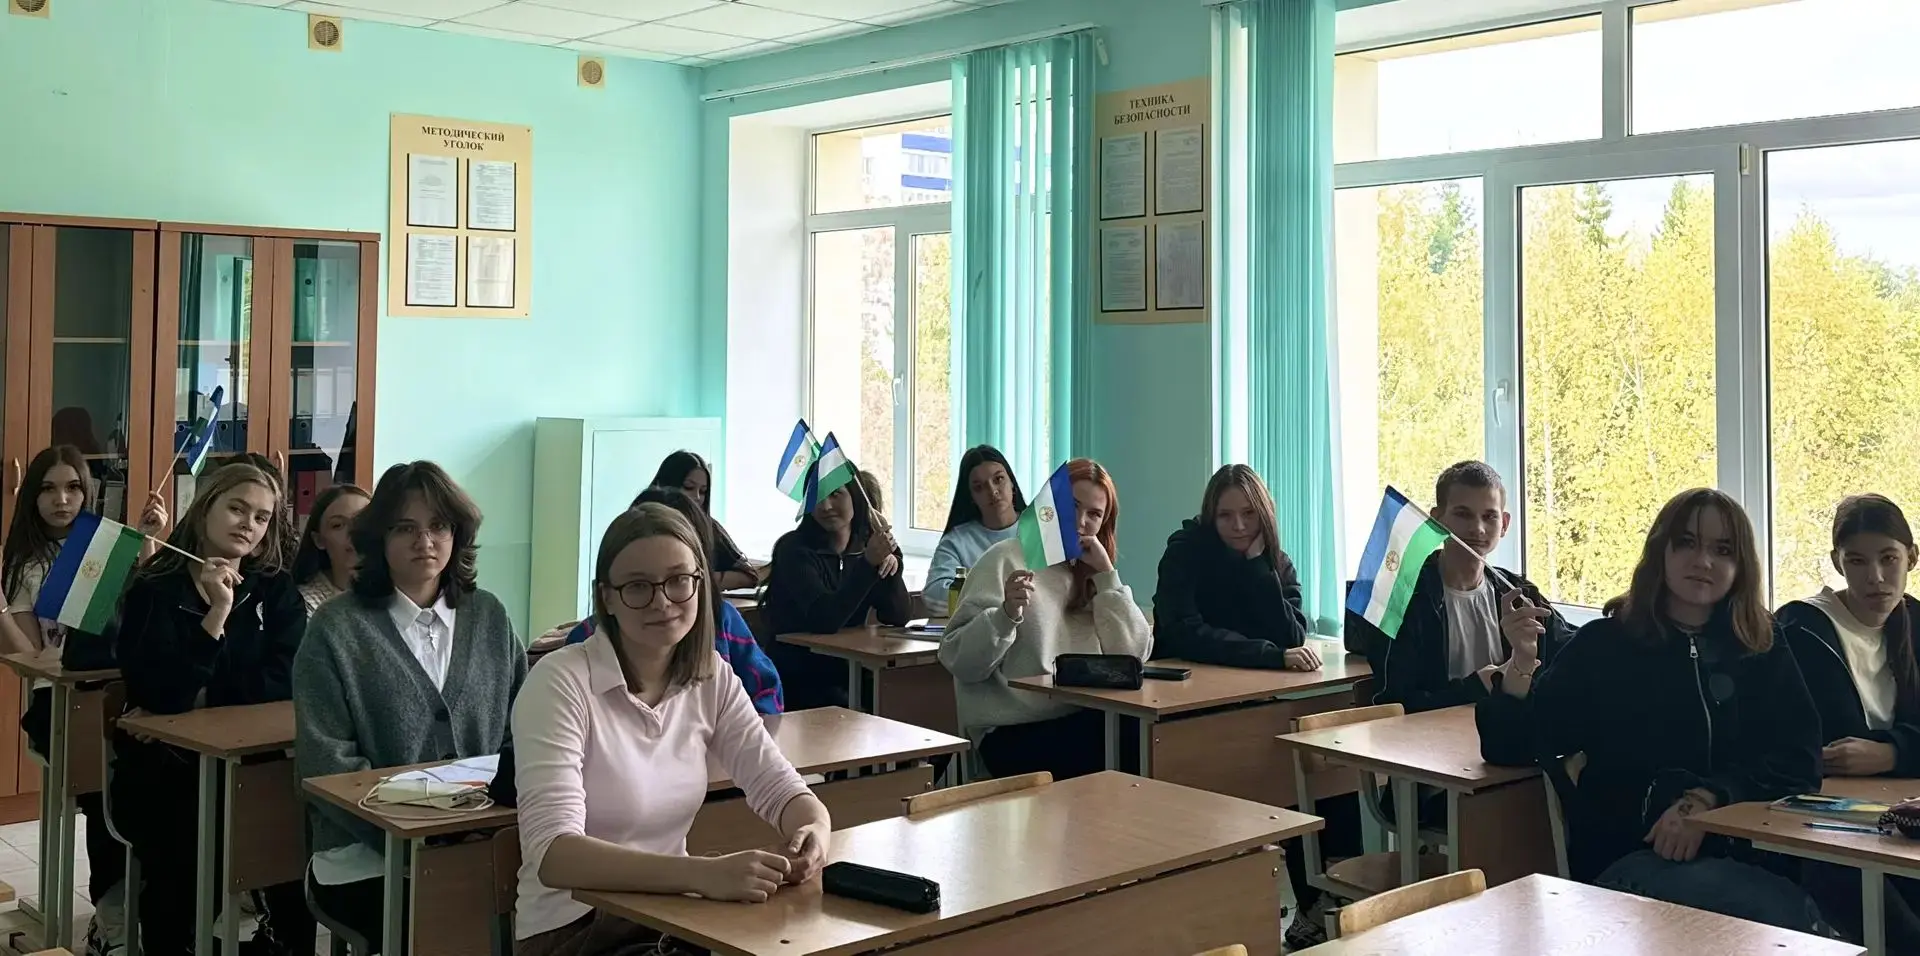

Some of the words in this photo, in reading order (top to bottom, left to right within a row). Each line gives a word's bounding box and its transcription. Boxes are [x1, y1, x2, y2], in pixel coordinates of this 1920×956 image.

[1129, 94, 1175, 110] ТЕХНИКА
[1114, 105, 1191, 125] БЕЗОПАСНОСТИ
[422, 126, 505, 142] МЕТОДИЧЕСКИЙ
[443, 139, 484, 151] УГОЛОК
